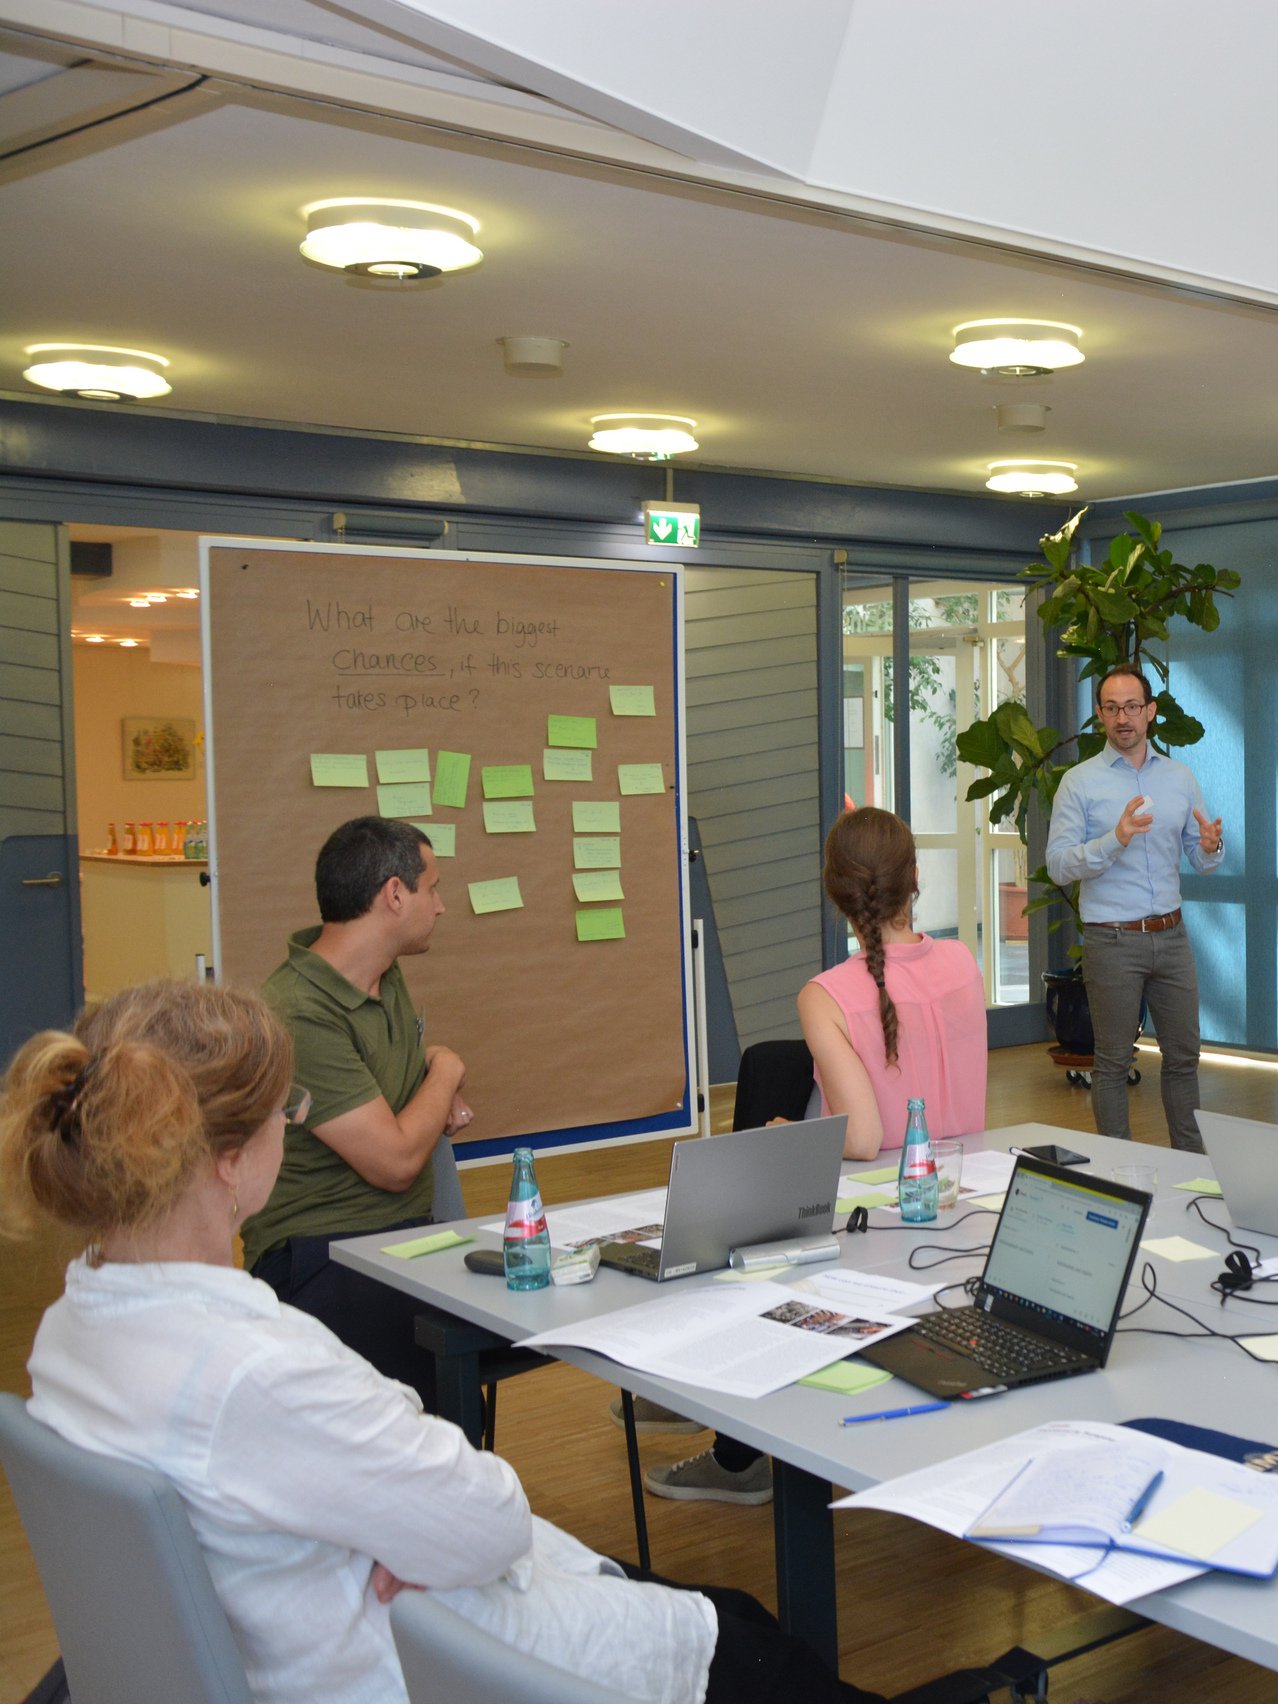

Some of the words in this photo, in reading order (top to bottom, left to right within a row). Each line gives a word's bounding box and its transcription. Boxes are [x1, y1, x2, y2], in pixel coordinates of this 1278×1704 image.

[307, 599, 374, 632] What
[395, 611, 437, 634] are
[444, 606, 484, 636] the
[496, 611, 561, 648] biggest
[488, 653, 522, 678] this
[332, 685, 386, 710] takes
[799, 1202, 831, 1219] ThinkBook
